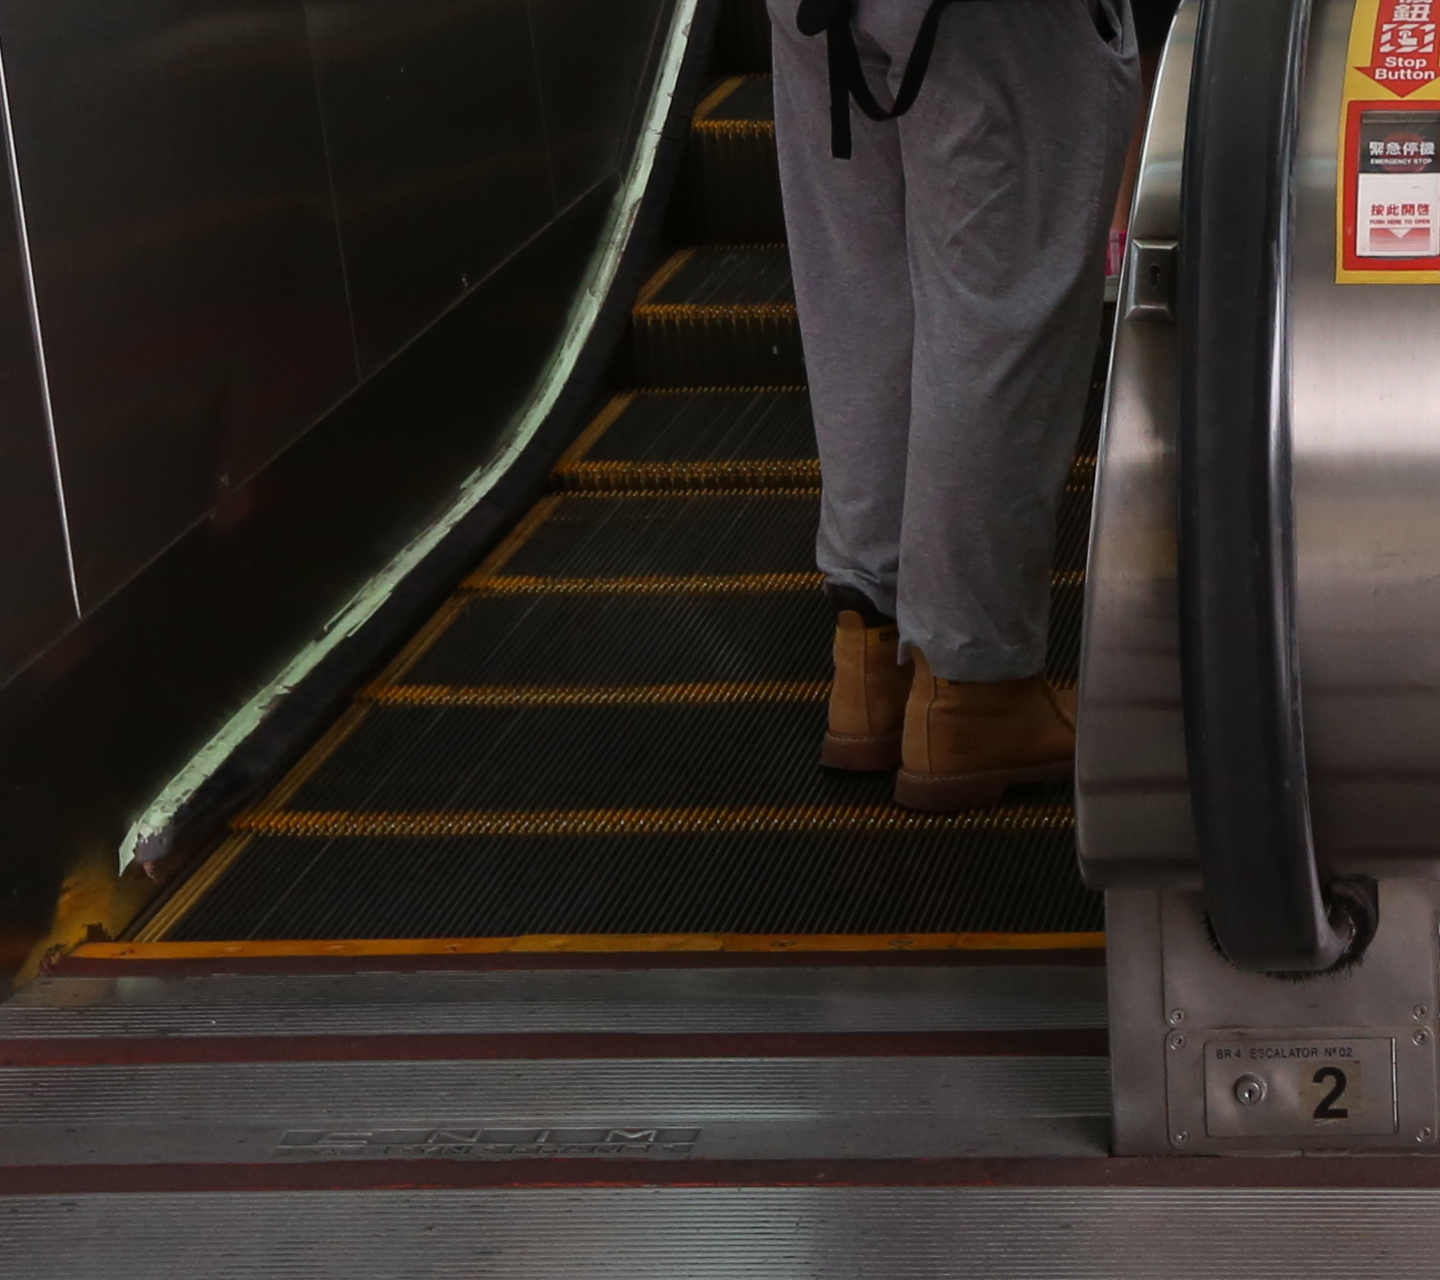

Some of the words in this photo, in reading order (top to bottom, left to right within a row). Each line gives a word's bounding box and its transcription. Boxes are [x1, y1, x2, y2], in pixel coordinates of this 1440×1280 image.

[1384, 55, 1428, 71] Stop
[1374, 67, 1436, 81] Button
[1368, 141, 1436, 157] 緊急停機
[1216, 1048, 1232, 1059] BR
[1234, 1048, 1242, 1058] 4
[1250, 1047, 1319, 1059] ESCALATOR
[1311, 1065, 1349, 1120] 2
